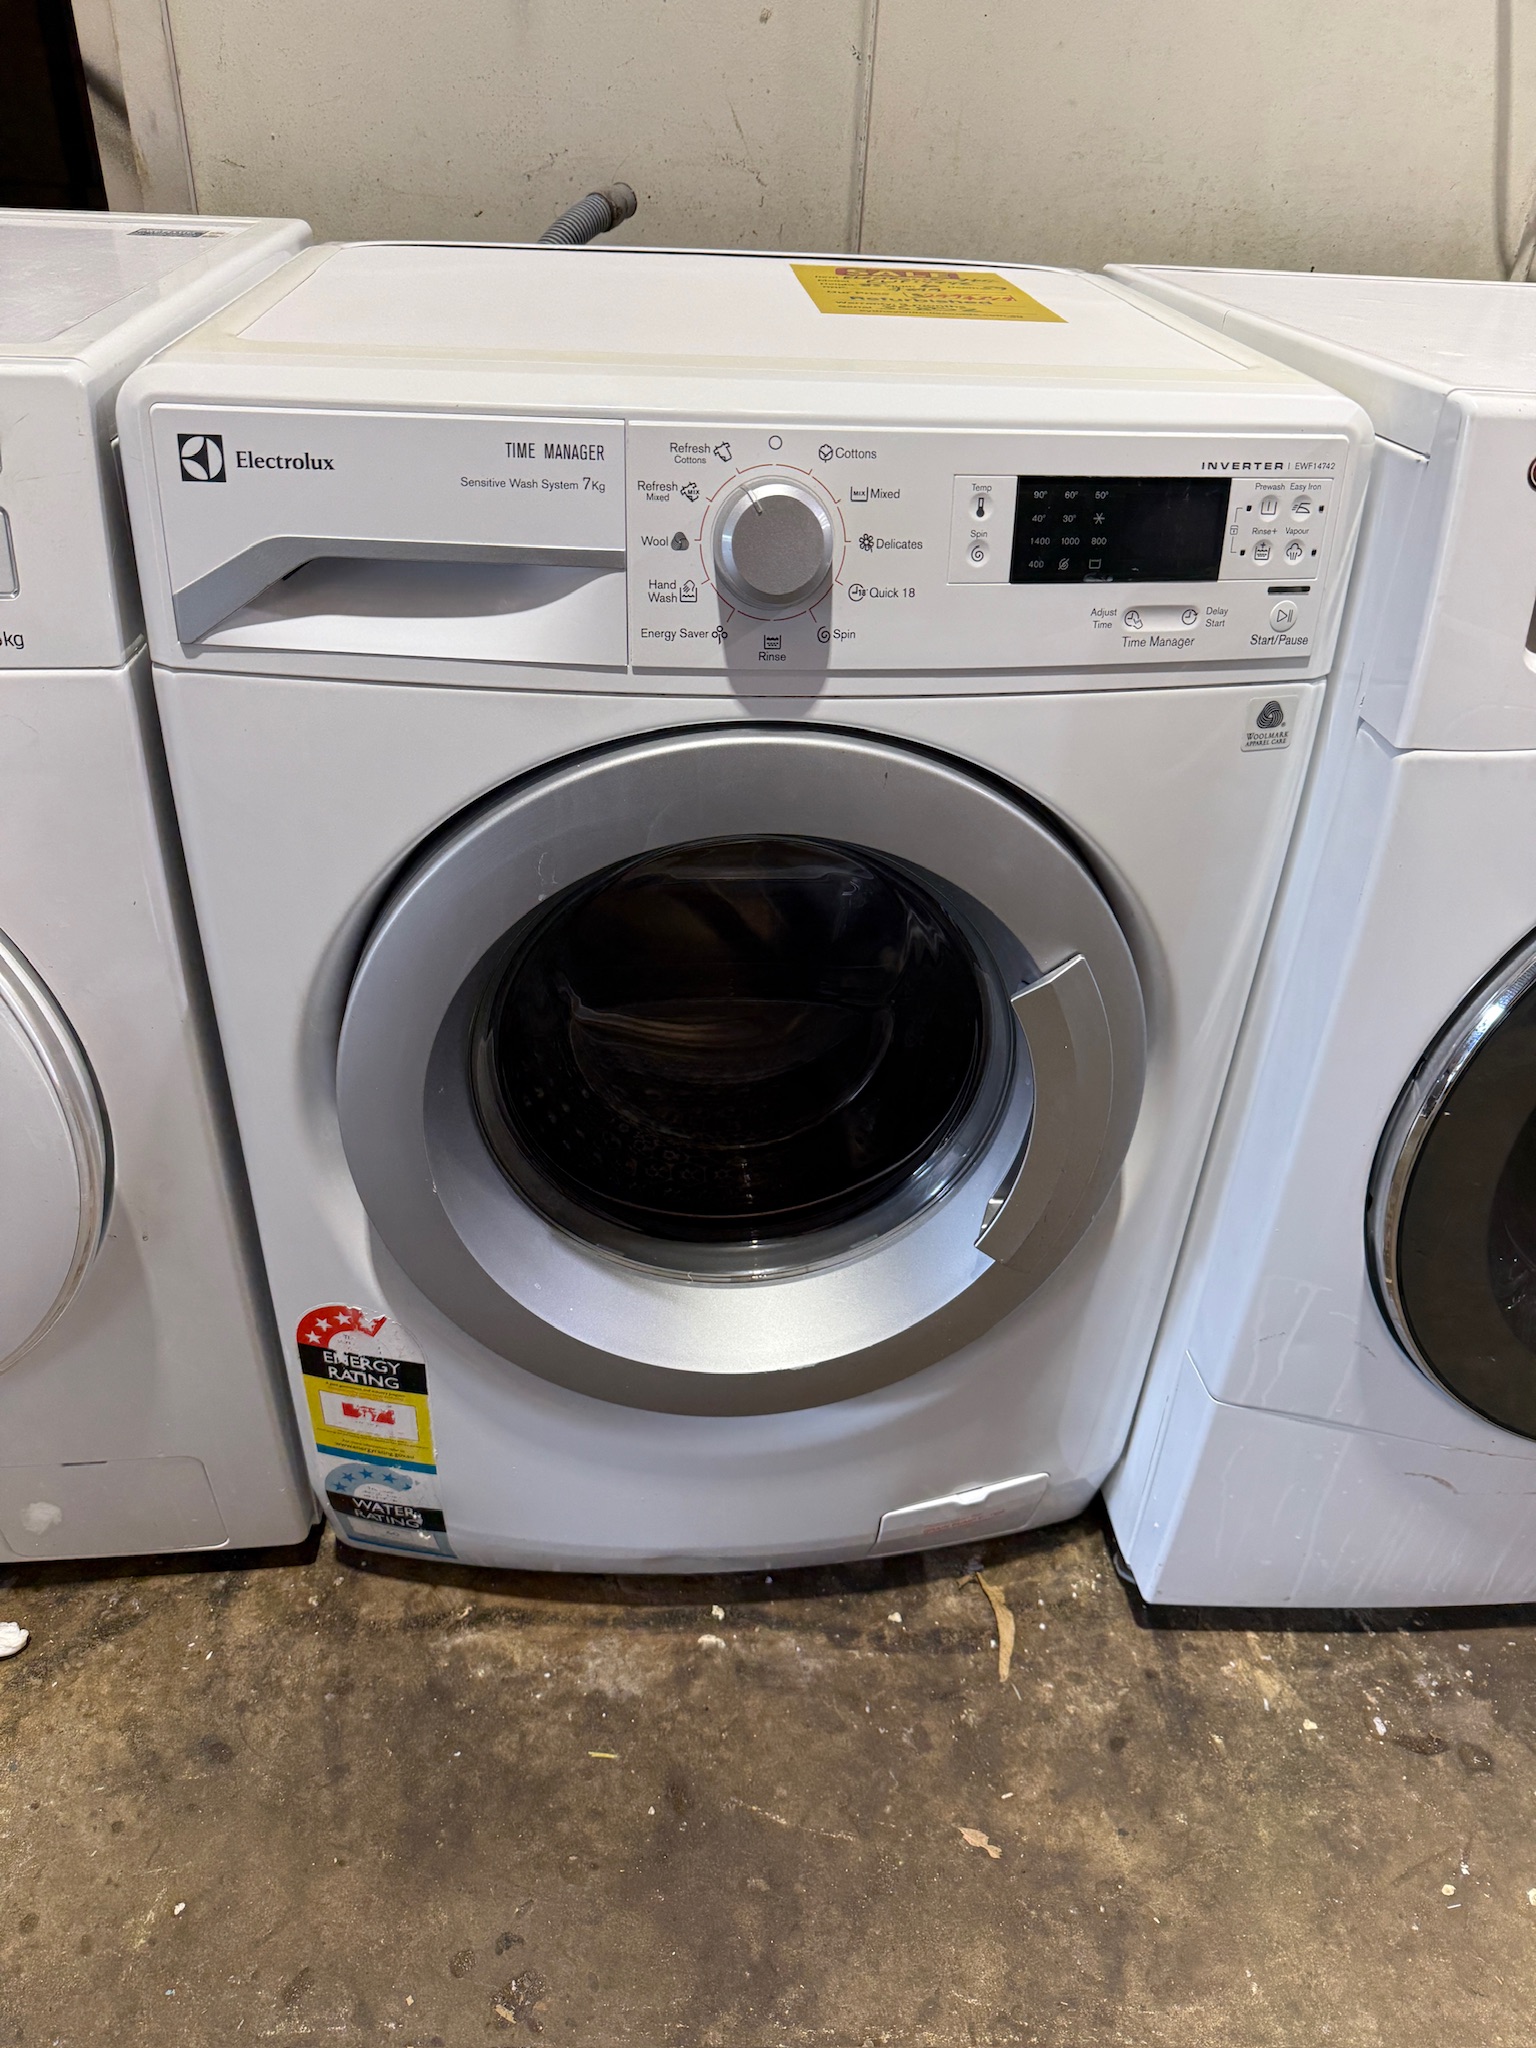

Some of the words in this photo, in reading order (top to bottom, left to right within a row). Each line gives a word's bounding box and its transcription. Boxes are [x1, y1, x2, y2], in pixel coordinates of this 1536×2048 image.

[505, 442, 536, 459] TIME
[544, 443, 605, 461] MANAGER
[670, 442, 711, 453] Refresh
[835, 448, 877, 459] Cottons
[236, 451, 335, 471] Electrolux
[674, 456, 707, 464] Cottons
[1201, 462, 1284, 470] INVERTER
[460, 476, 506, 488] Sensitive
[509, 479, 538, 488] Wash
[541, 478, 579, 491] System
[637, 481, 678, 491] Refresh
[972, 483, 993, 493] Temp
[1255, 482, 1286, 491] Prewash
[1290, 483, 1306, 492] Easy
[646, 492, 670, 502] Mixed
[870, 488, 900, 499] Mixed
[970, 529, 988, 540] Spin
[1252, 527, 1278, 535] Rinse+
[1285, 528, 1310, 537] Vapour
[641, 537, 669, 547] Wool
[877, 539, 923, 550] Delicates
[1030, 537, 1051, 546] 1400
[1061, 537, 1080, 546] 1000
[1091, 537, 1107, 546] 800
[1028, 560, 1044, 569] 400
[649, 580, 676, 590] Hand
[648, 593, 678, 603] Wash
[869, 588, 899, 599] Quick
[902, 588, 916, 598] 18
[1090, 608, 1117, 618] Adjust
[1206, 607, 1228, 617] Delay
[1093, 621, 1112, 630] Time
[1206, 620, 1225, 628] Start
[641, 629, 677, 642] Energy
[679, 629, 709, 640] Saver
[833, 629, 856, 642] Spin
[1250, 634, 1309, 646] Start/Pause
[1122, 637, 1146, 648] Time
[1150, 636, 1194, 650] Manager
[758, 652, 787, 662] Rinse
[1247, 731, 1289, 740] WOOLMARK
[323, 1351, 400, 1374] ENERGY
[328, 1366, 399, 1389] RATING
[352, 1498, 414, 1517] WATER
[354, 1509, 420, 1529] RATING
